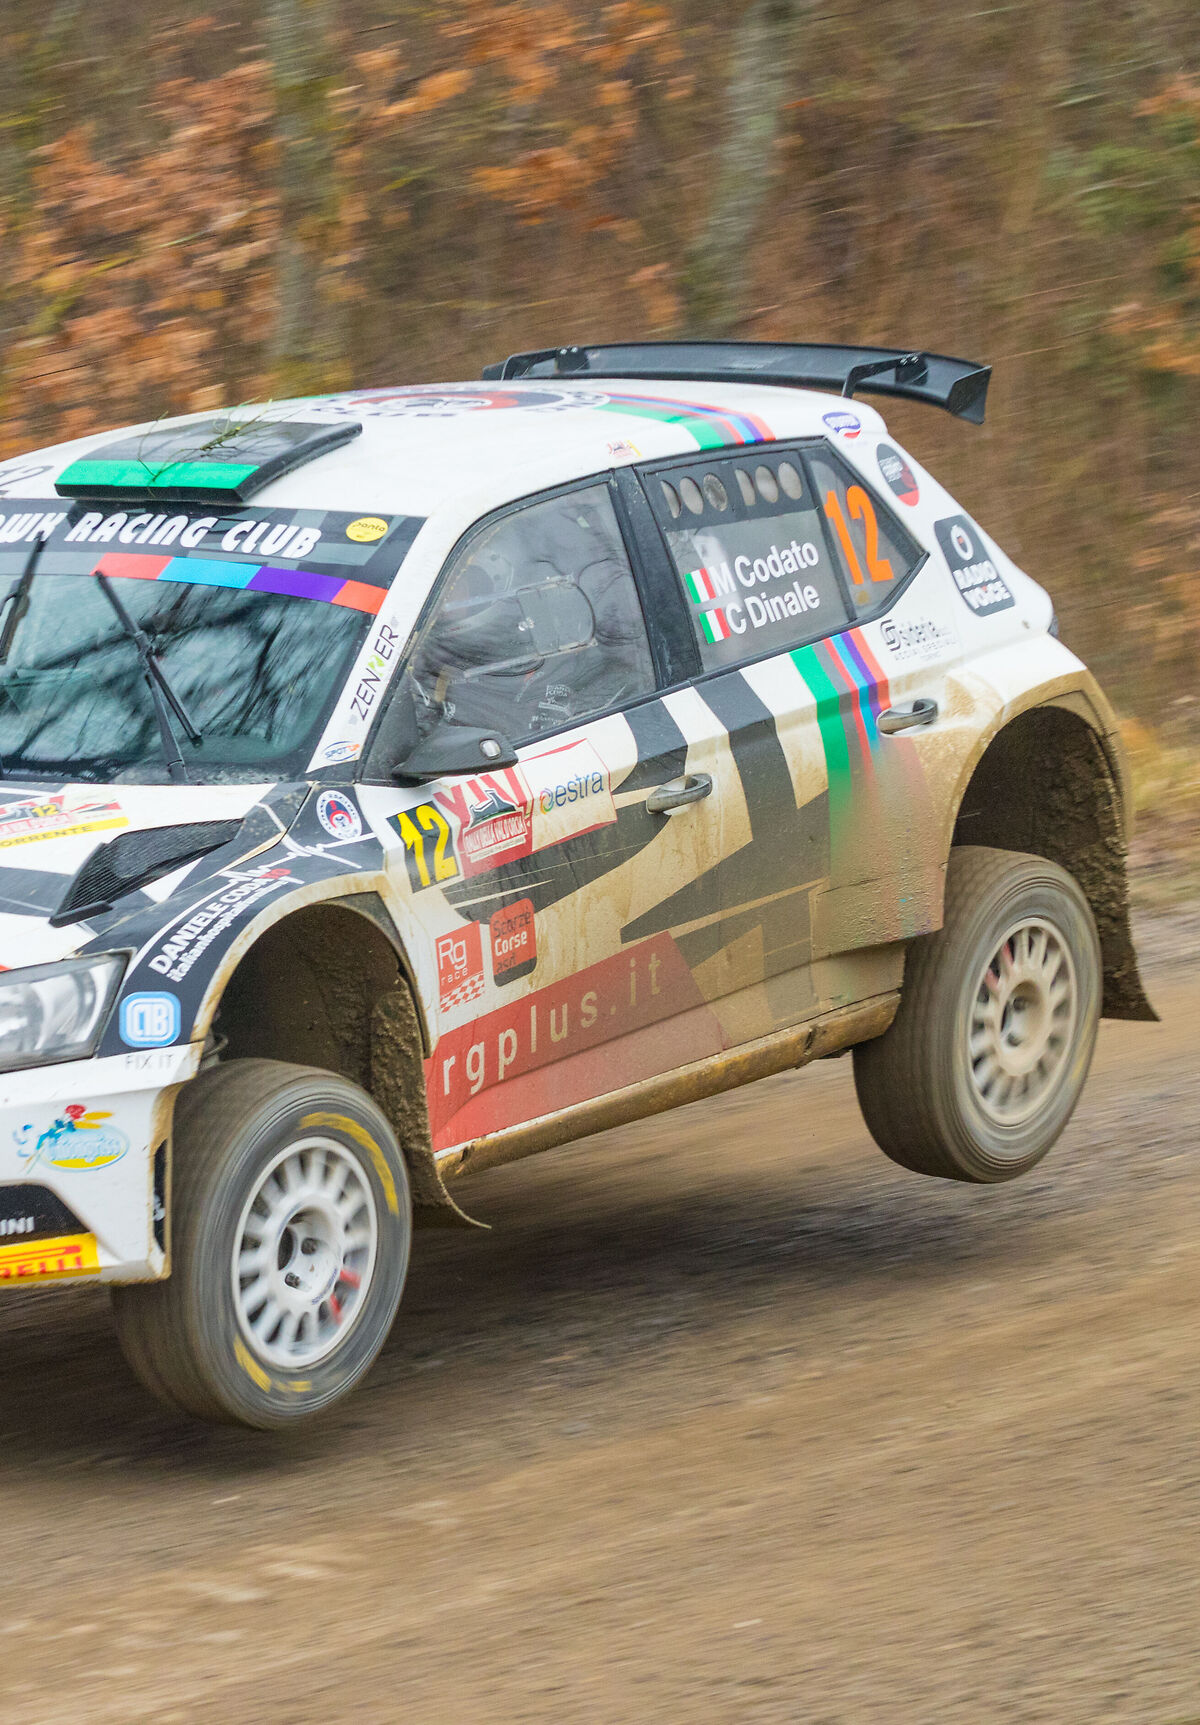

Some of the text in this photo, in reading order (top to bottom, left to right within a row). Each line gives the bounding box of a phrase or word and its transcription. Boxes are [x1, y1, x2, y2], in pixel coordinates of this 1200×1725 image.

[64, 511, 218, 547] RACING
[221, 521, 322, 558] CLUB
[824, 485, 894, 585] 12
[708, 540, 819, 597] M Codato
[725, 581, 820, 634] C Dinale
[32, 803, 60, 818] 12
[555, 771, 604, 807] estra
[397, 805, 458, 887] 12
[148, 902, 226, 975] DANIELE
[438, 938, 468, 970] Rg
[494, 931, 528, 956] Corse
[440, 967, 469, 985] race
[443, 952, 662, 1096] rgplus.it
